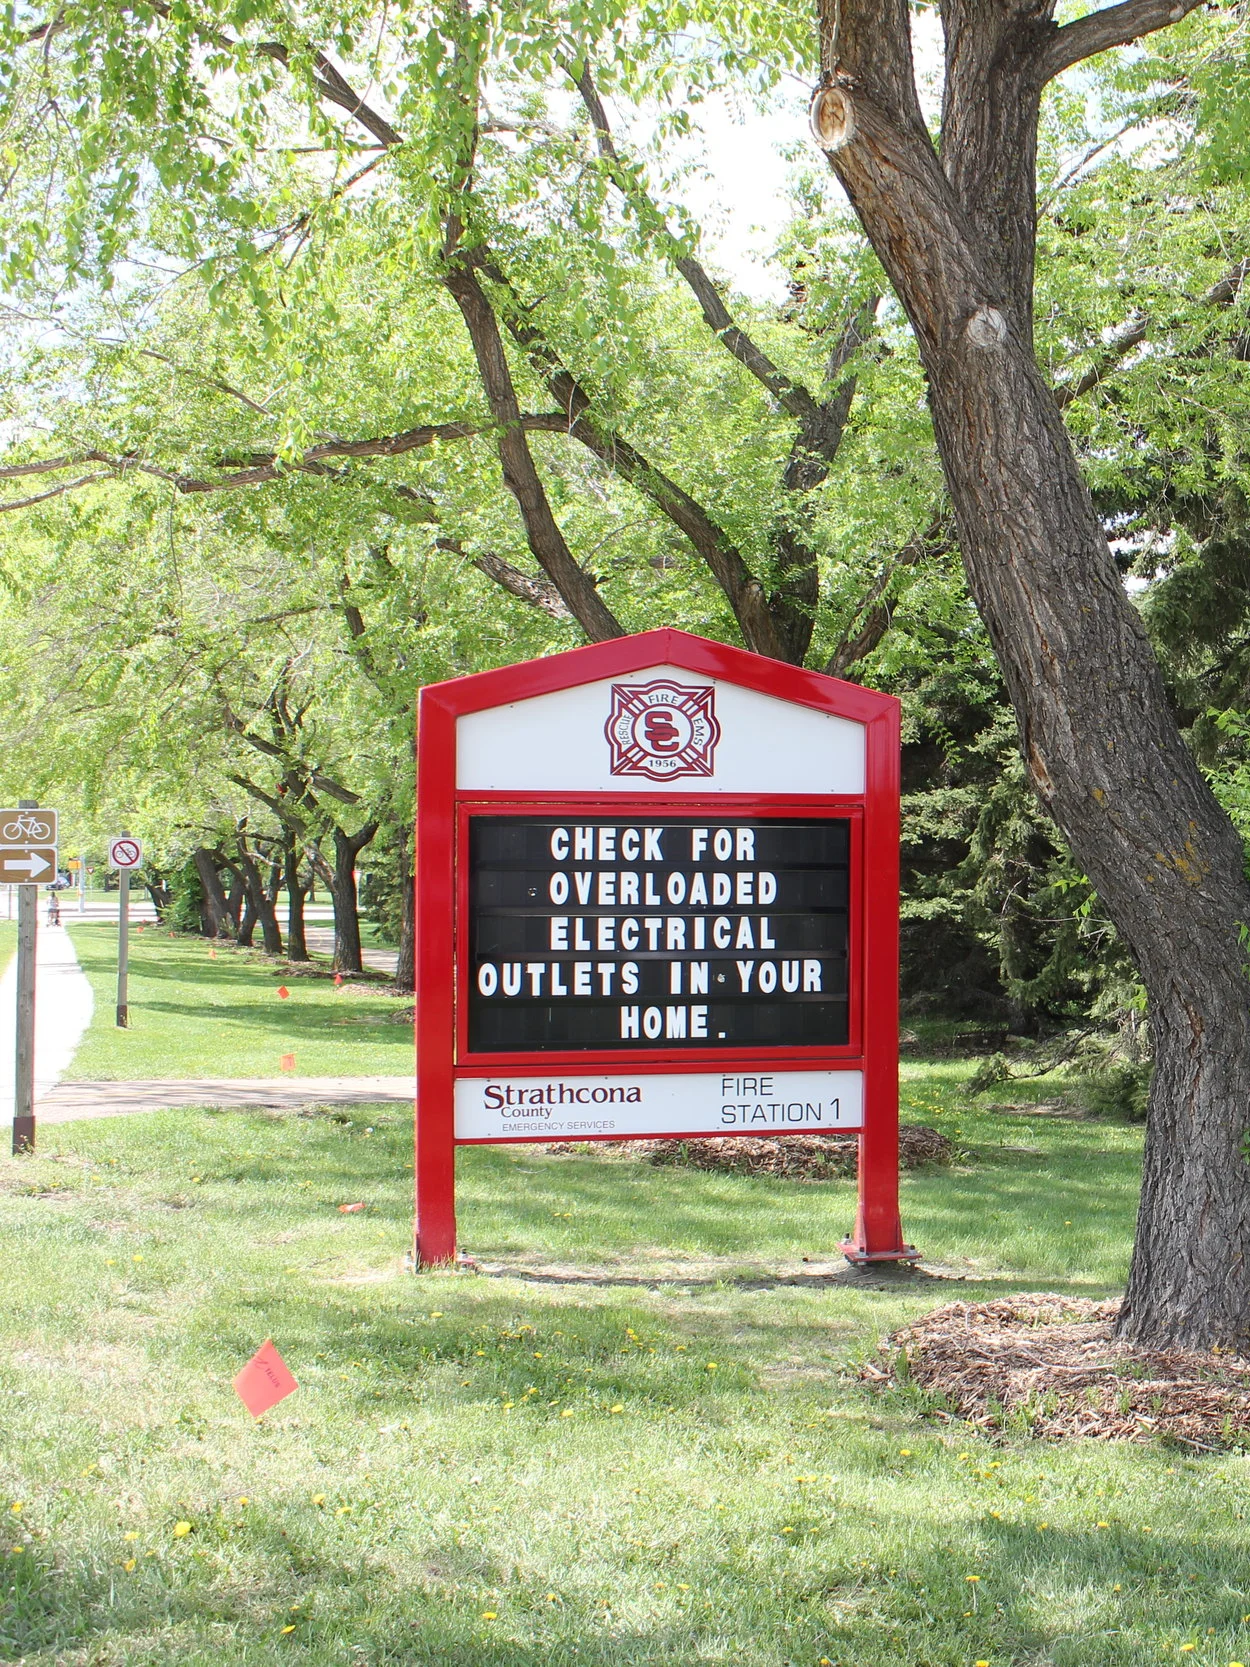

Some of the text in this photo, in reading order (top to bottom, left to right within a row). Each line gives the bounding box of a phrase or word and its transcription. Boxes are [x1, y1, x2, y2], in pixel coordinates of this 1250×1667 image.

[648, 693, 679, 705] FIRE
[618, 714, 633, 746] RESCUE
[693, 717, 704, 747] EMS
[649, 759, 677, 768] 1956
[550, 827, 755, 861] CHECK FOR
[549, 871, 777, 905] OVERLOADED
[550, 916, 775, 950] ELECTRICAL
[478, 959, 822, 997] OUTLETS IN YOUR
[483, 1083, 642, 1110] Strathcona
[721, 1077, 774, 1097] FIRE
[500, 1106, 552, 1119] County
[720, 1097, 840, 1125] STATION 1
[502, 1120, 616, 1132] EMERGENCY SERVICES
